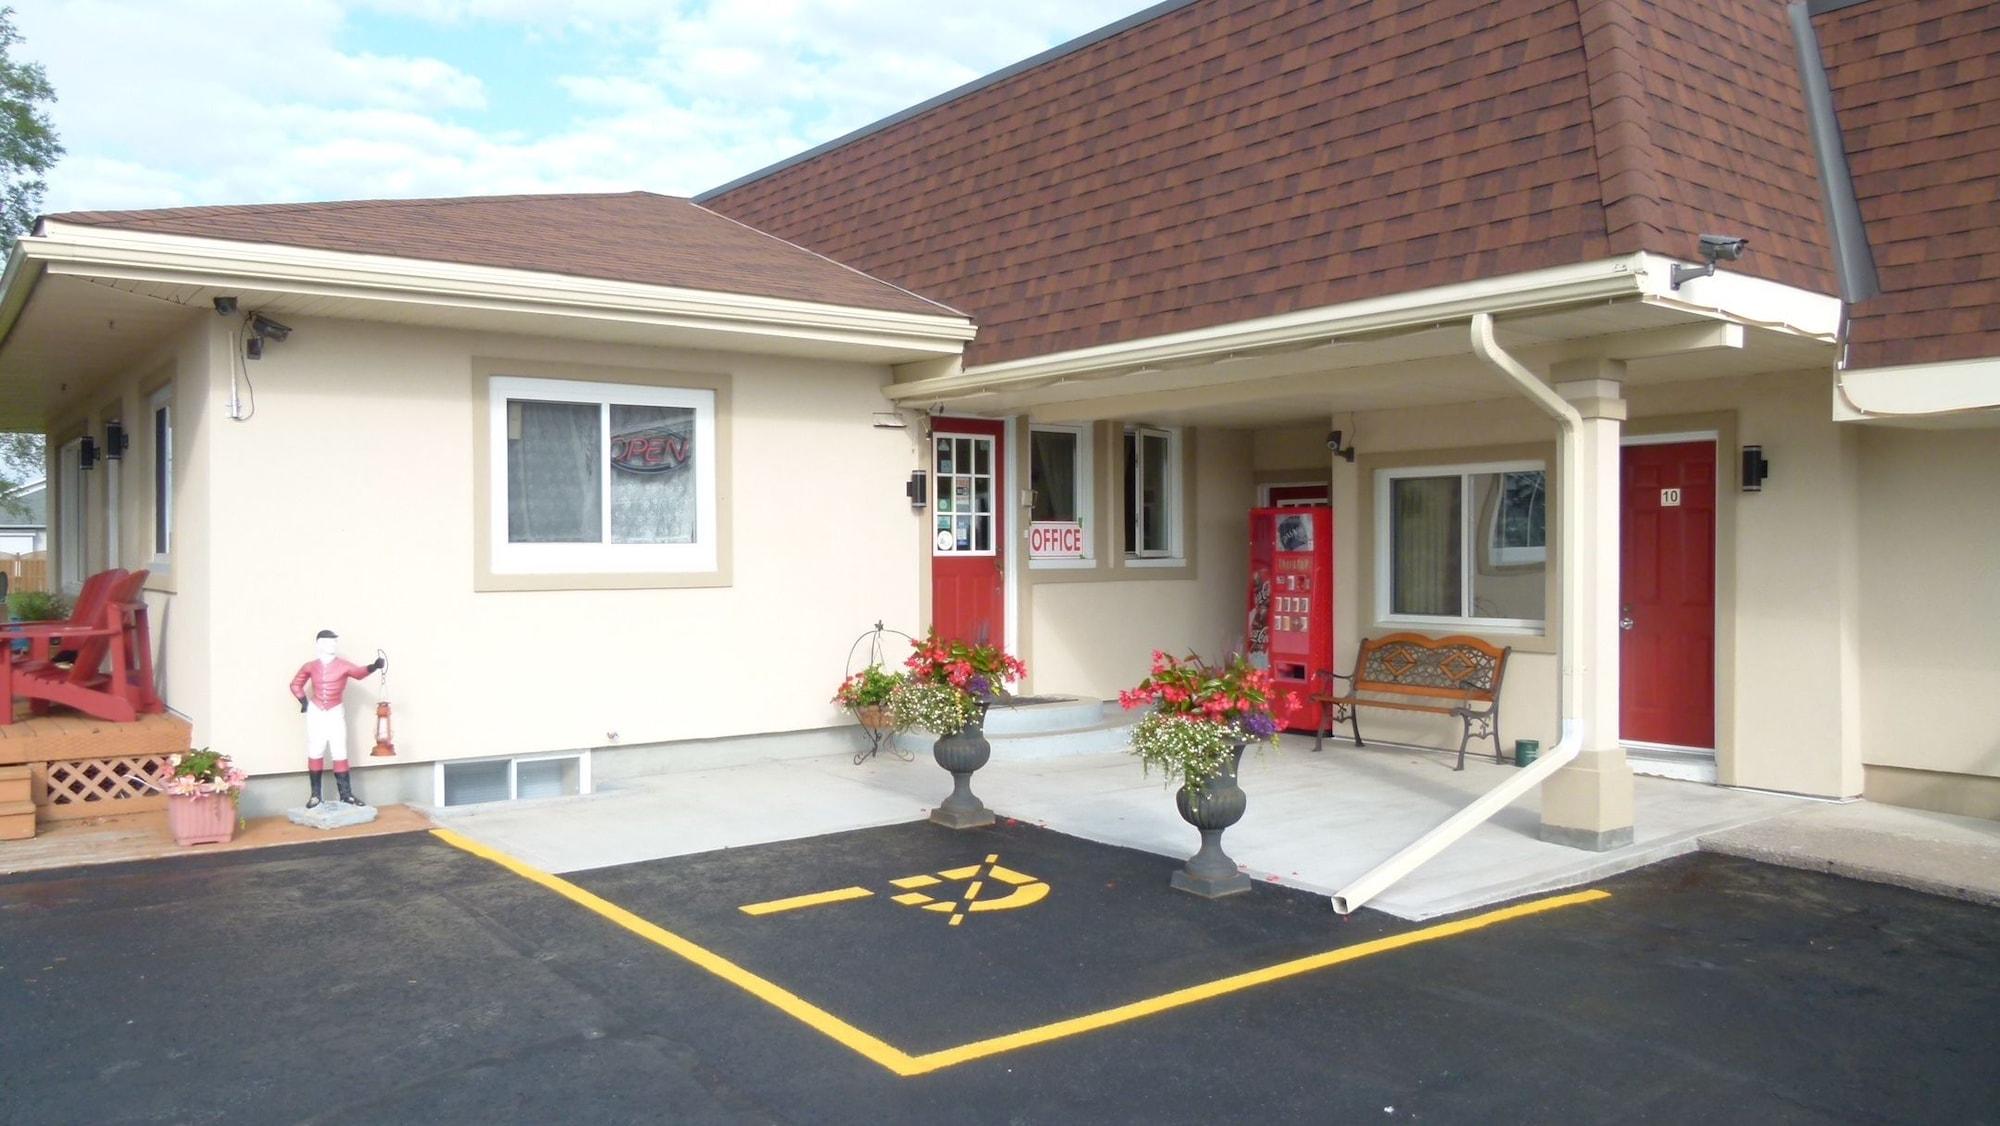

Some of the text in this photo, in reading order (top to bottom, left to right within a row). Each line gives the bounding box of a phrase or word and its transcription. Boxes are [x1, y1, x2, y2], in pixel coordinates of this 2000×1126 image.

[611, 436, 689, 464] OPEN
[1663, 490, 1678, 502] 10
[1031, 528, 1081, 552] OFFICE
